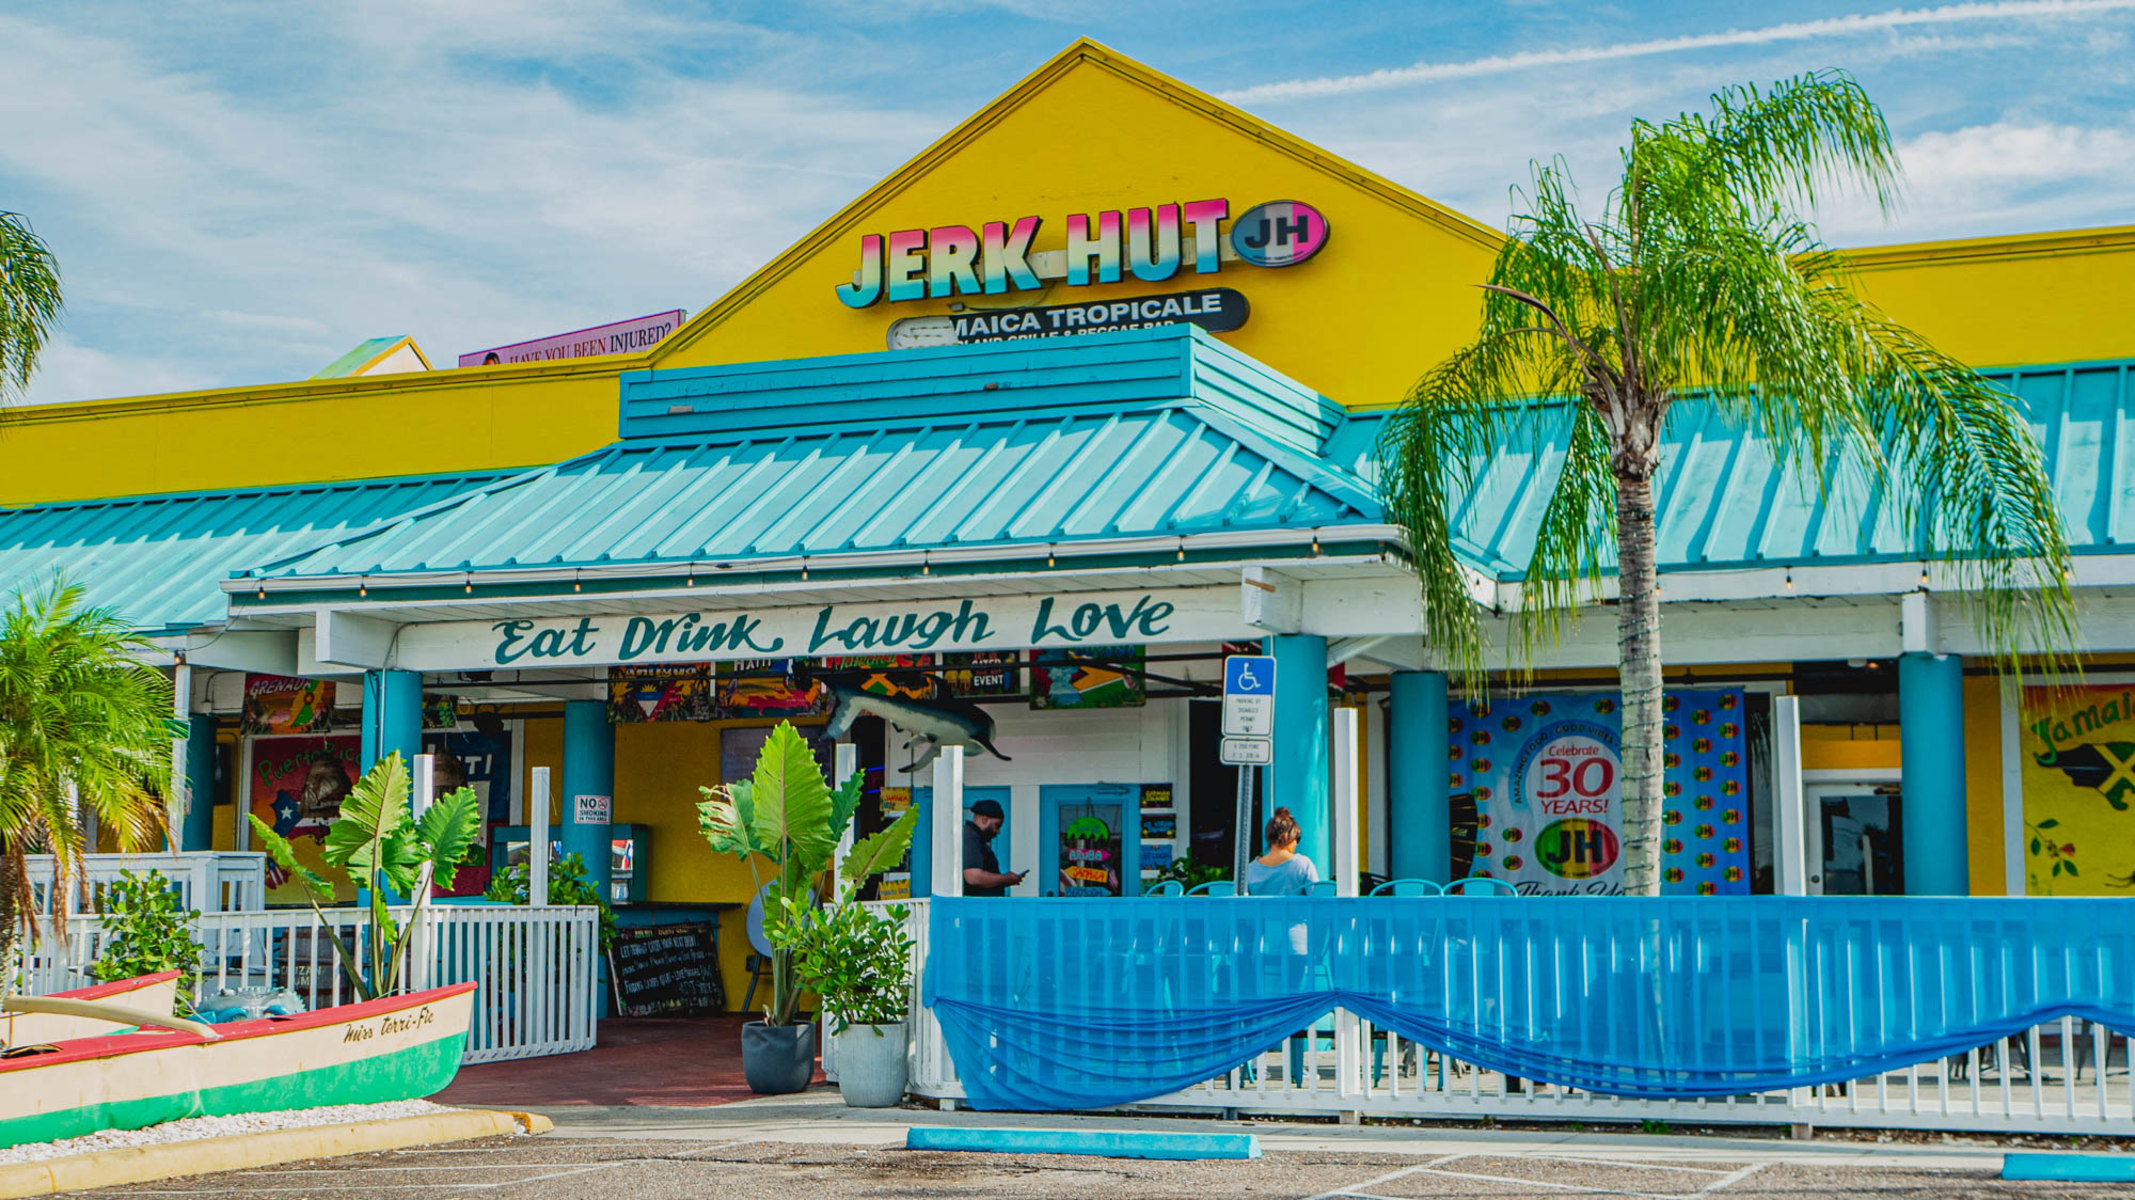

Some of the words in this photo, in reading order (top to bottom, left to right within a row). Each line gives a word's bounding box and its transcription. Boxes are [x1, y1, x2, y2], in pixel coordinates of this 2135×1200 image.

[1244, 215, 1308, 249] JH
[835, 215, 1044, 309] JERK
[1067, 197, 1229, 287] HUT
[1046, 293, 1222, 328] TROPICALE
[573, 337, 607, 358] BEEN
[491, 617, 600, 665] Eat
[618, 612, 785, 662] Drink
[808, 600, 996, 653] Laugh
[1031, 594, 1175, 644] Love
[973, 674, 1004, 687] EVENT
[2029, 691, 2135, 765] Jamai
[1548, 744, 1600, 757] Celebrate
[1537, 757, 1614, 799] 30
[580, 798, 597, 809] NO
[1541, 799, 1610, 815] YEARS!
[1069, 849, 1103, 861] ARUBA
[1546, 830, 1603, 864] JH
[1587, 880, 1626, 896] Yo
